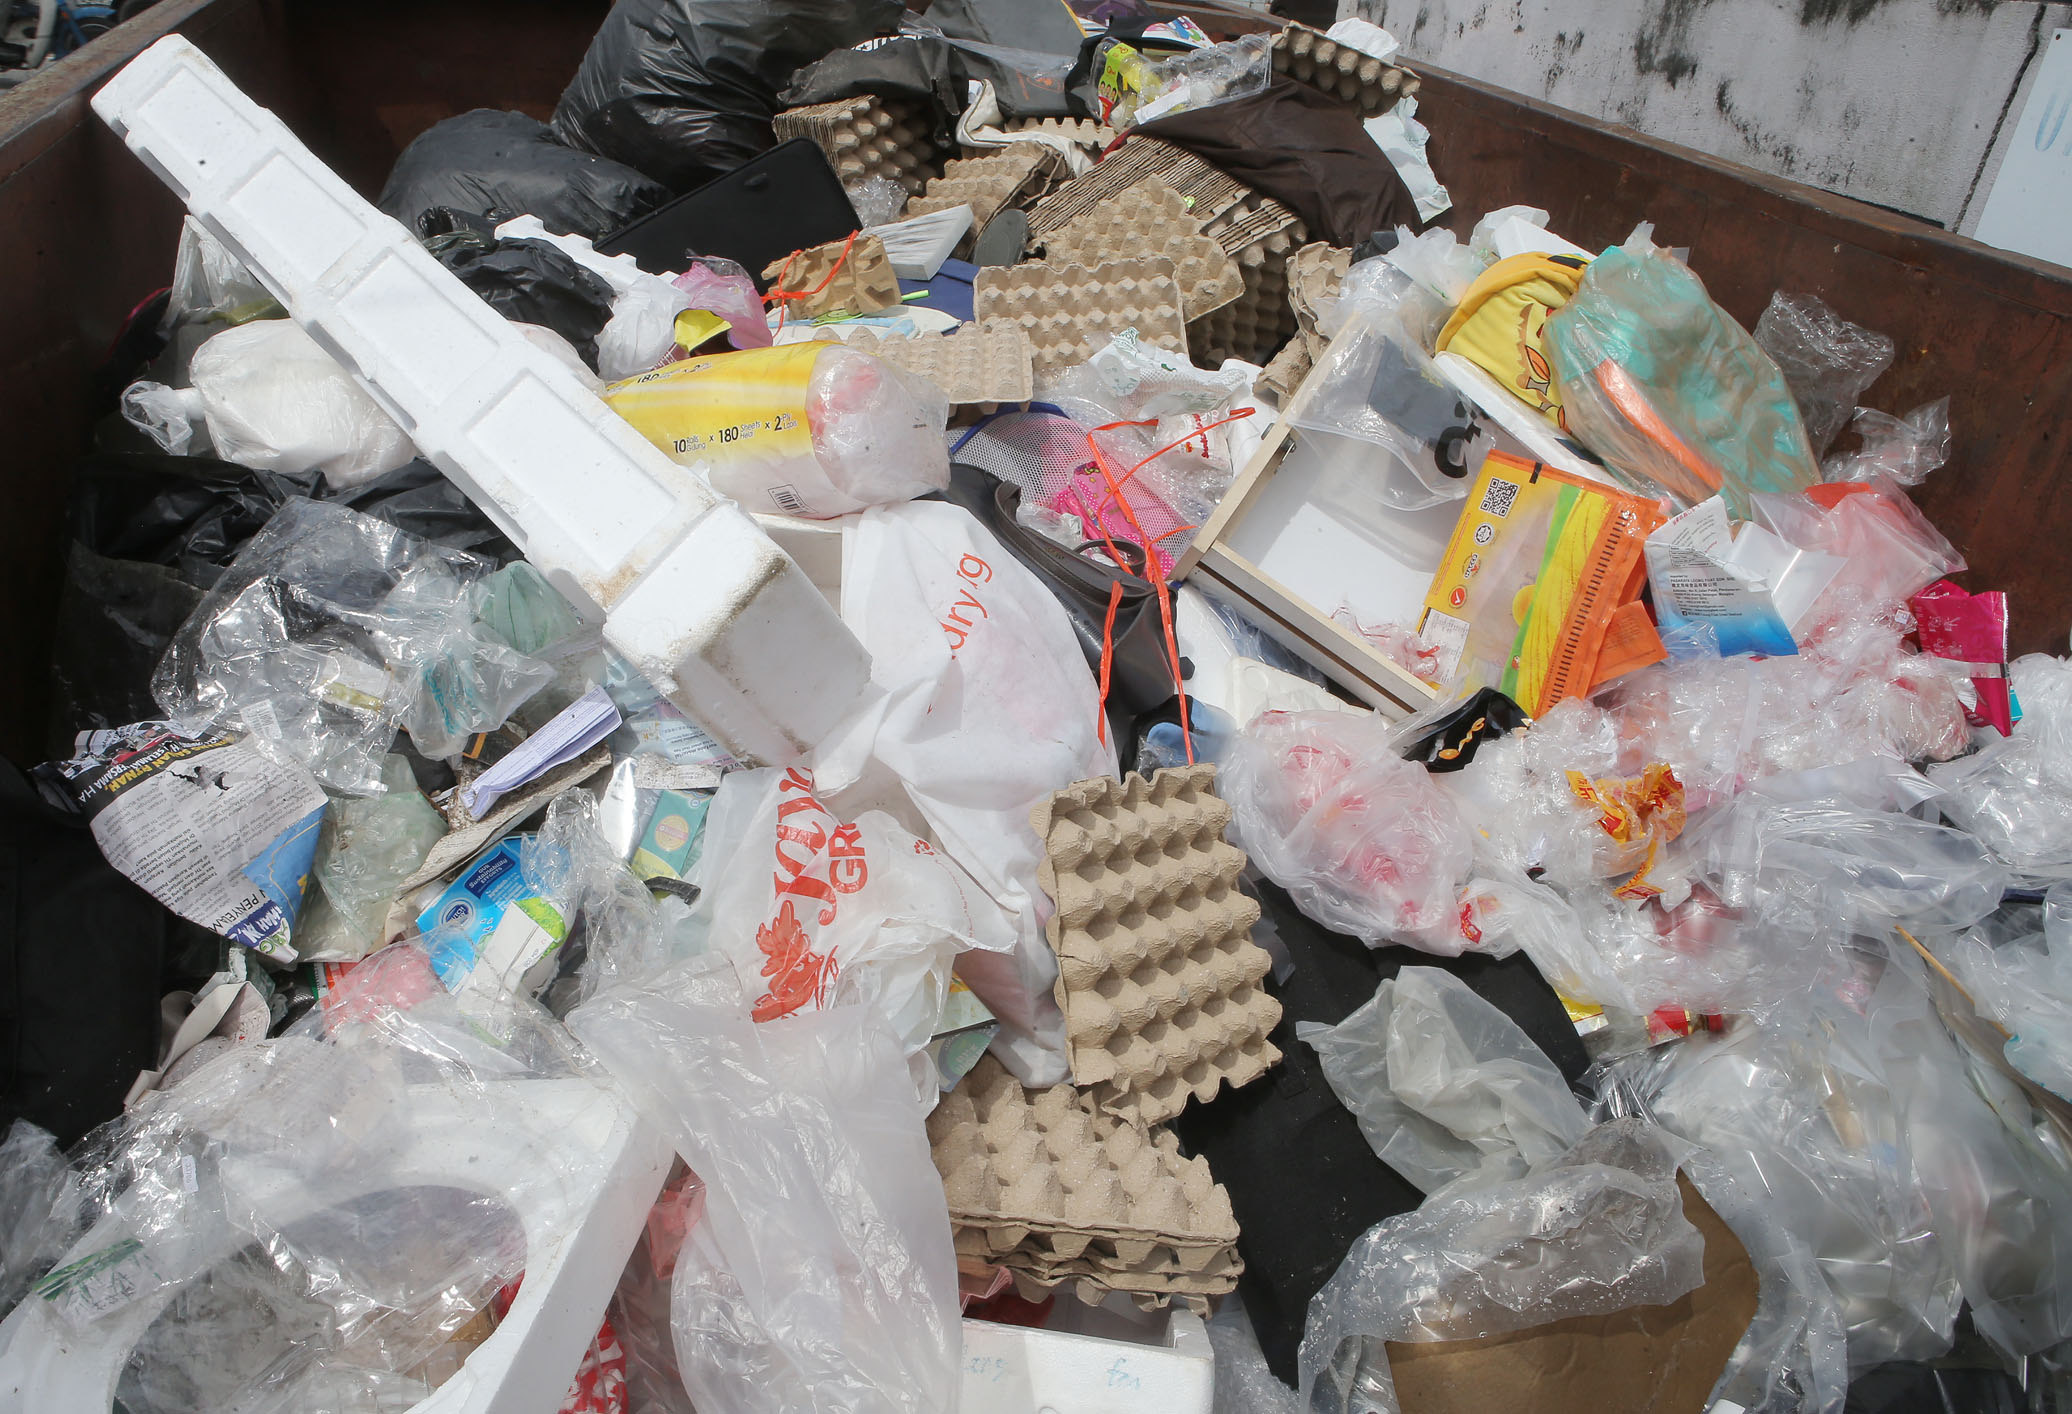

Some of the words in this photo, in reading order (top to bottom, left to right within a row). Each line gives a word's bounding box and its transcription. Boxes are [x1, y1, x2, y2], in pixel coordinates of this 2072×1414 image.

[673, 439, 687, 454] 10
[718, 426, 739, 442] 180
[741, 420, 761, 431] Sheets
[764, 421, 770, 429] x
[774, 416, 782, 430] 2
[93, 762, 129, 788] ERSAMA
[468, 857, 508, 889] Sustainability
